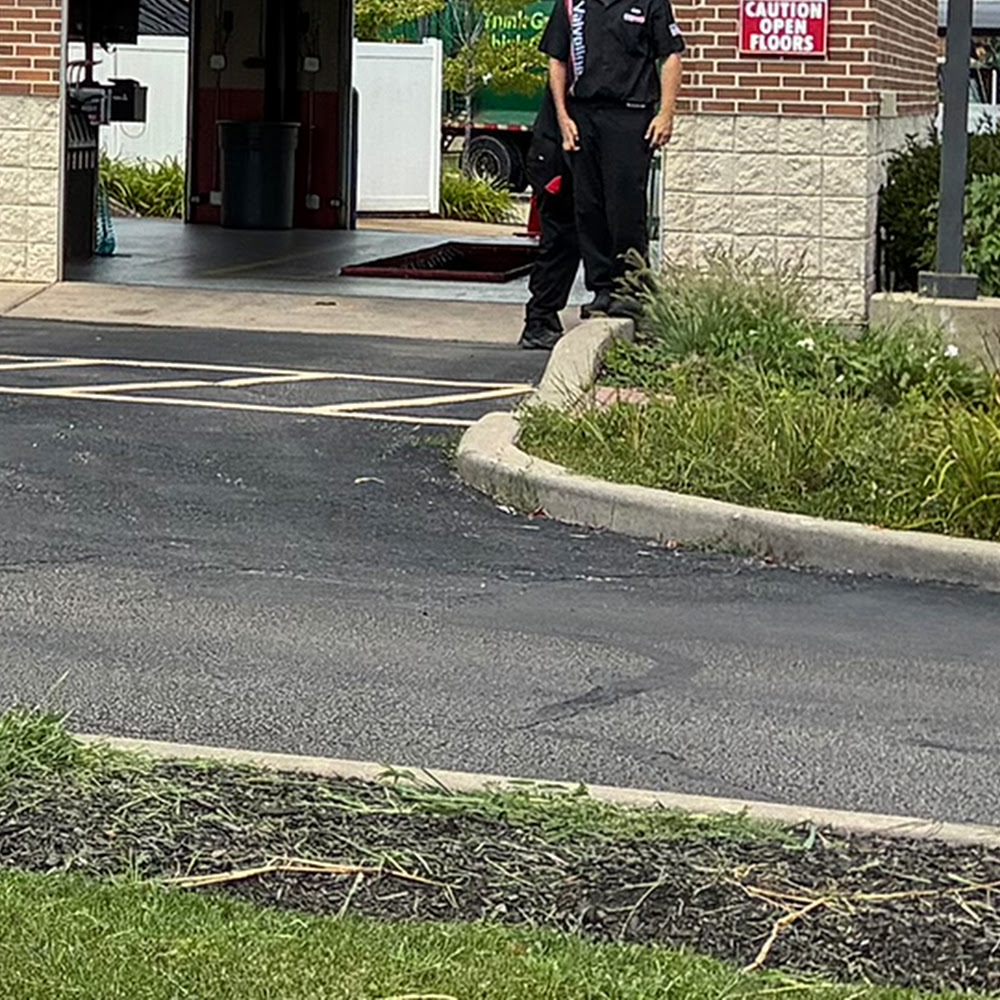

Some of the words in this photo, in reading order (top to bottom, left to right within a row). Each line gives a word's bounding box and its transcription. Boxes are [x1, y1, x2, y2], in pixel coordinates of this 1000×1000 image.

[744, 1, 823, 19] CAUTION
[759, 18, 807, 34] OPEN
[571, 0, 586, 76] Valvoline
[749, 34, 814, 51] FLOORS
